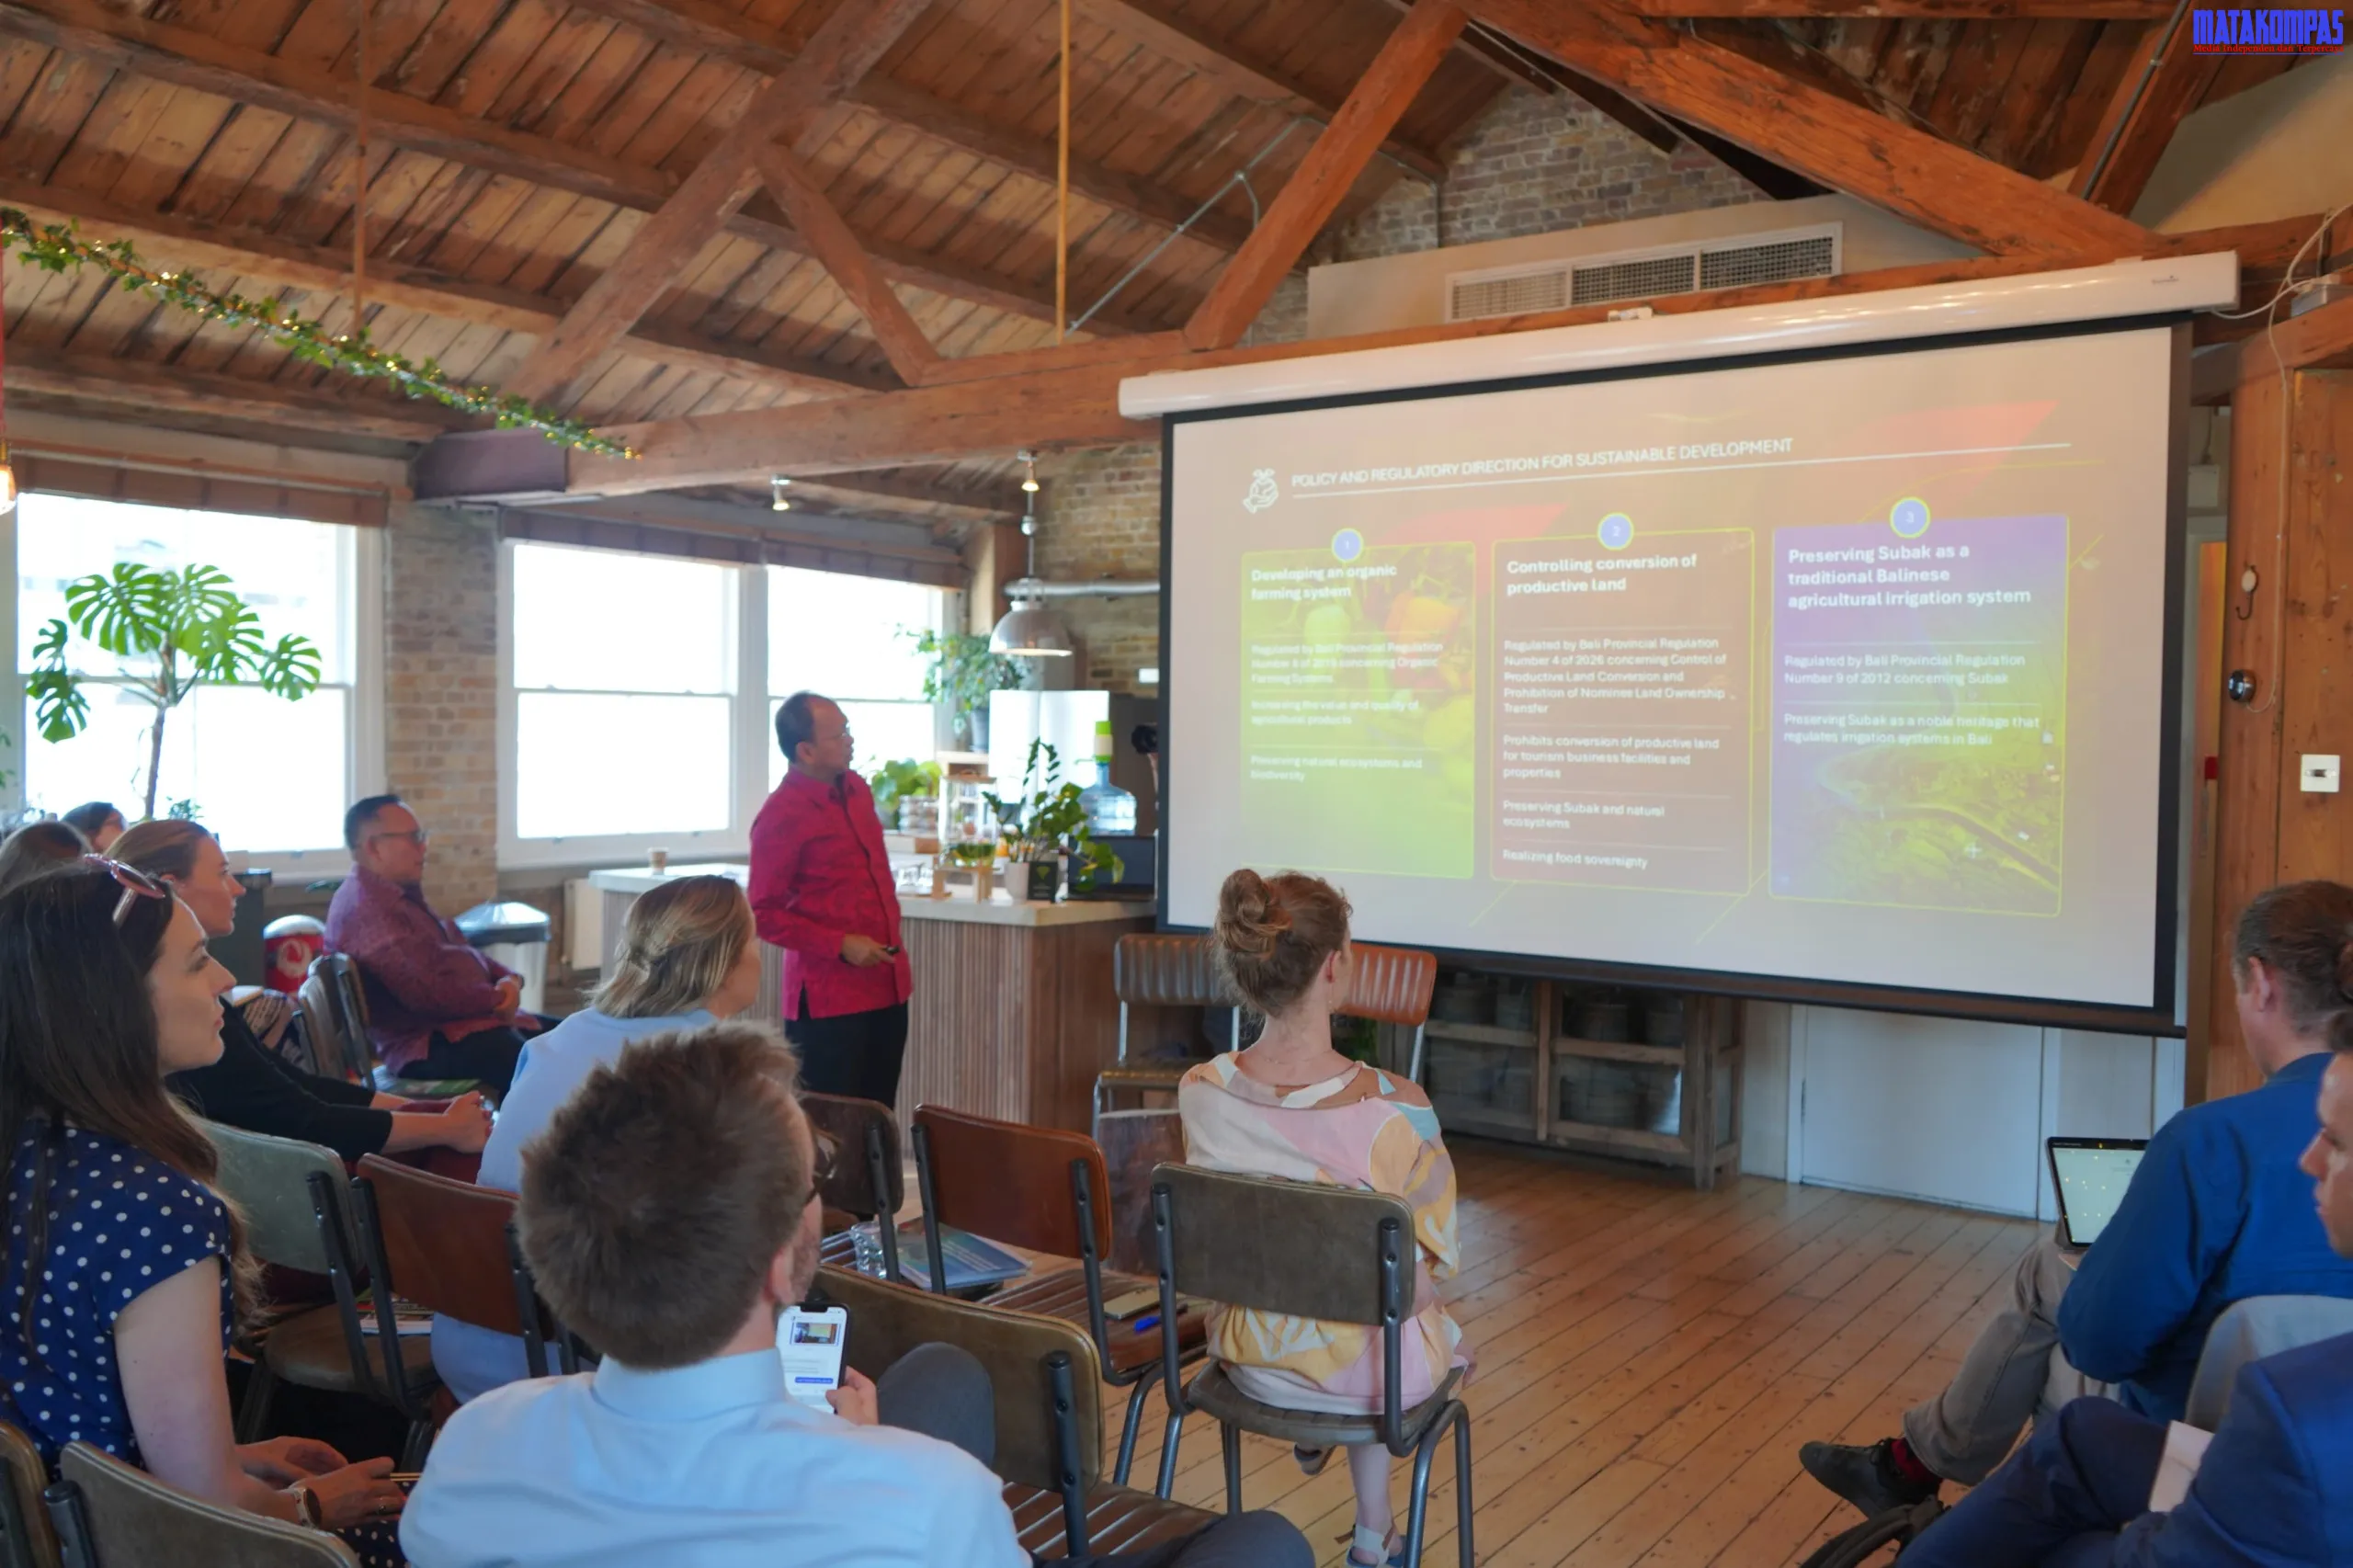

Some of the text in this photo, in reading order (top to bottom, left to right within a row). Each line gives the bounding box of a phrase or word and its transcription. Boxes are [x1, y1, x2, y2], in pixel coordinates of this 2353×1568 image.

[1291, 437, 1793, 487] POLICY AND REGULATORY DIRECTION FOR SUSTAINABLE DEVELOPMENT
[1905, 511, 1915, 524] 3
[1612, 526, 1621, 537] 2
[1788, 544, 1970, 564] Preserving Subak as a
[1506, 553, 1698, 574] Controlling conversion of
[1251, 563, 1397, 583] Developing an organic
[1788, 567, 1950, 585] traditional Balinese
[1251, 585, 1351, 601] farming system
[1506, 577, 1627, 597] productive land
[1788, 589, 2031, 610] agricultural irrigation system
[1504, 637, 1720, 653] Regulated by Bali Provincial Regulation
[1397, 657, 1438, 669] Organic
[1504, 656, 1550, 666] Number
[1561, 654, 1574, 665] of
[1607, 654, 1669, 667] concerning
[1671, 653, 1712, 665] Control
[1715, 653, 1727, 665] of
[1784, 653, 2026, 669] Regulated by Bali Provincial Regulation
[1504, 670, 1685, 682] Productive Land Conversion and
[1784, 672, 2009, 687] Number 9 of 2012 concerning Subak
[1504, 687, 1564, 699] Prohibition
[1567, 687, 1579, 699] of
[1635, 687, 1662, 699] Land
[1665, 687, 1726, 700] Ownership
[1504, 703, 1549, 714] Transfer
[1784, 713, 2040, 730] Preserving Subak as a noble heritage that
[1504, 734, 1720, 751] Prohibits conversion of productive land
[1784, 731, 1993, 746] regulates irrigation systems in Bali
[1504, 750, 1691, 766] for tourism business facilities and
[1503, 767, 1562, 780] properties
[1504, 801, 1665, 817] Preserving Subak and natural
[1503, 816, 1570, 830] ecosystems
[1503, 848, 1649, 870] Realizing food sovereignty
